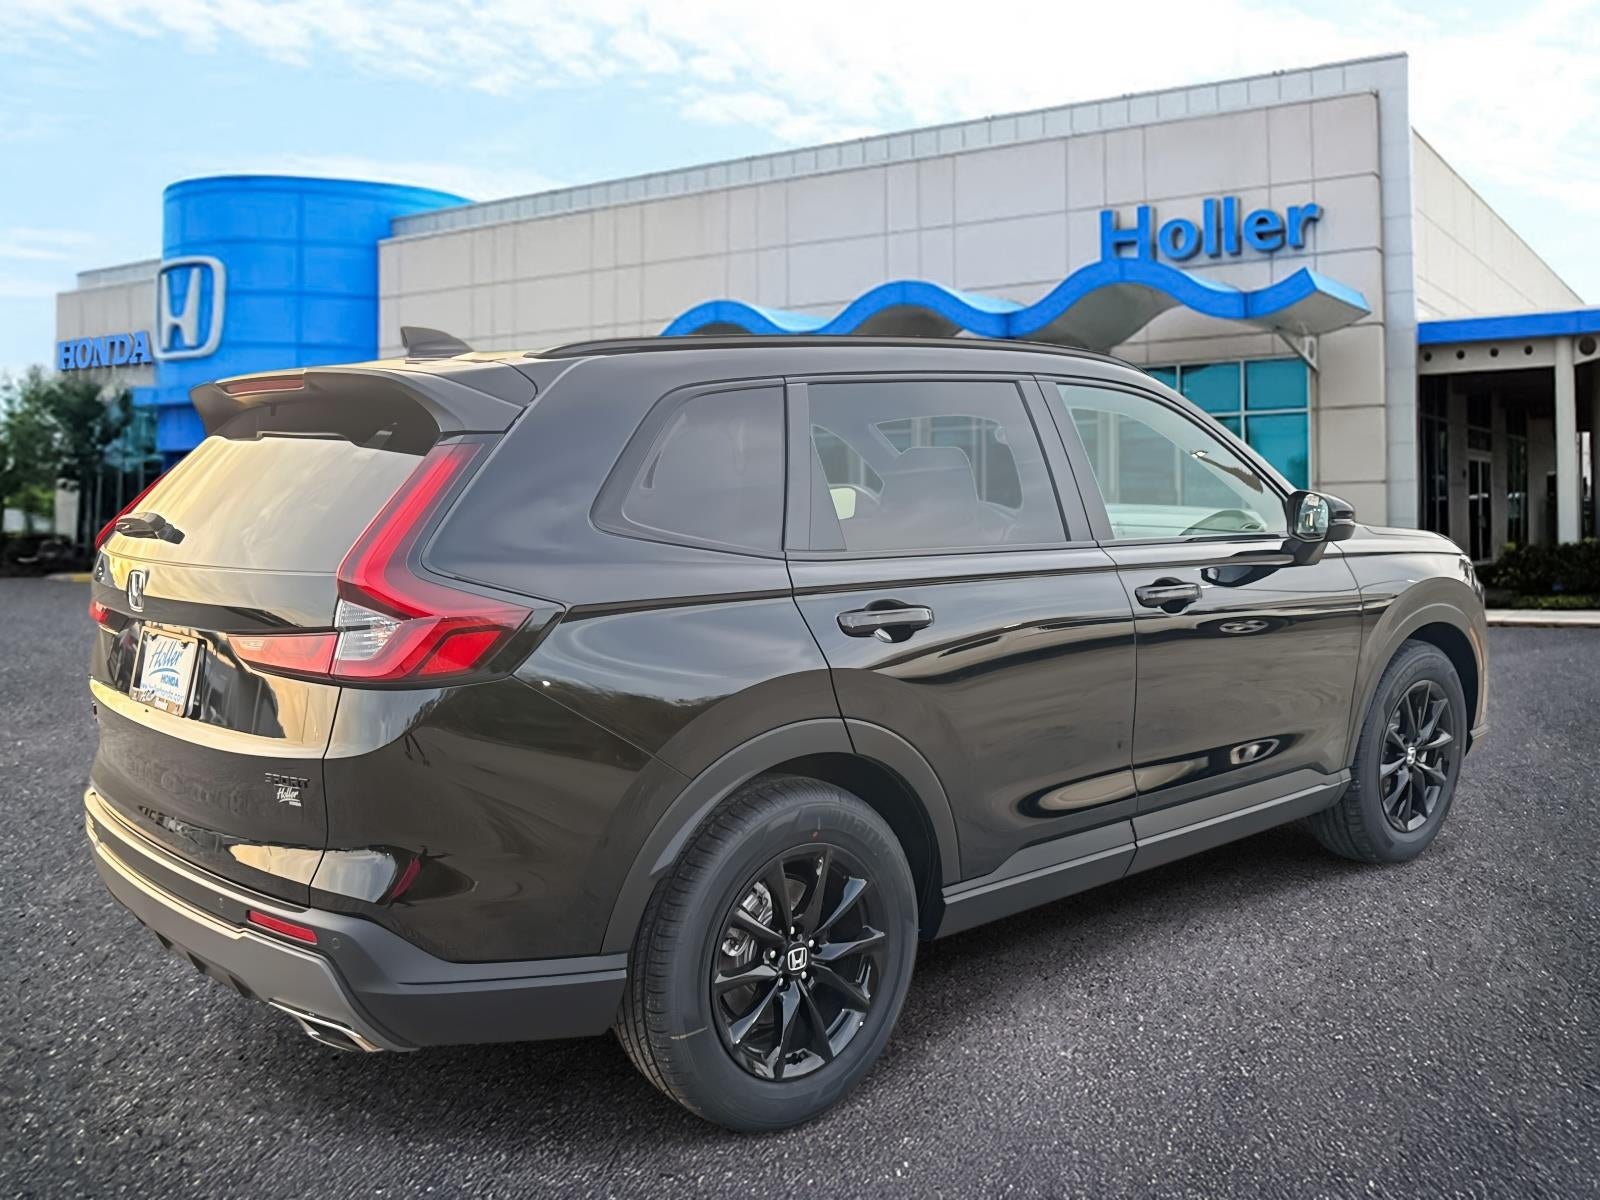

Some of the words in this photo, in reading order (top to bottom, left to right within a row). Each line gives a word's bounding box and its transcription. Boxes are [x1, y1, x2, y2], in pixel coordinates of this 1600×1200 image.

[1100, 196, 1323, 261] Holler
[58, 331, 153, 371] HONDA
[148, 639, 184, 669] Holler
[161, 673, 179, 689] HONDA
